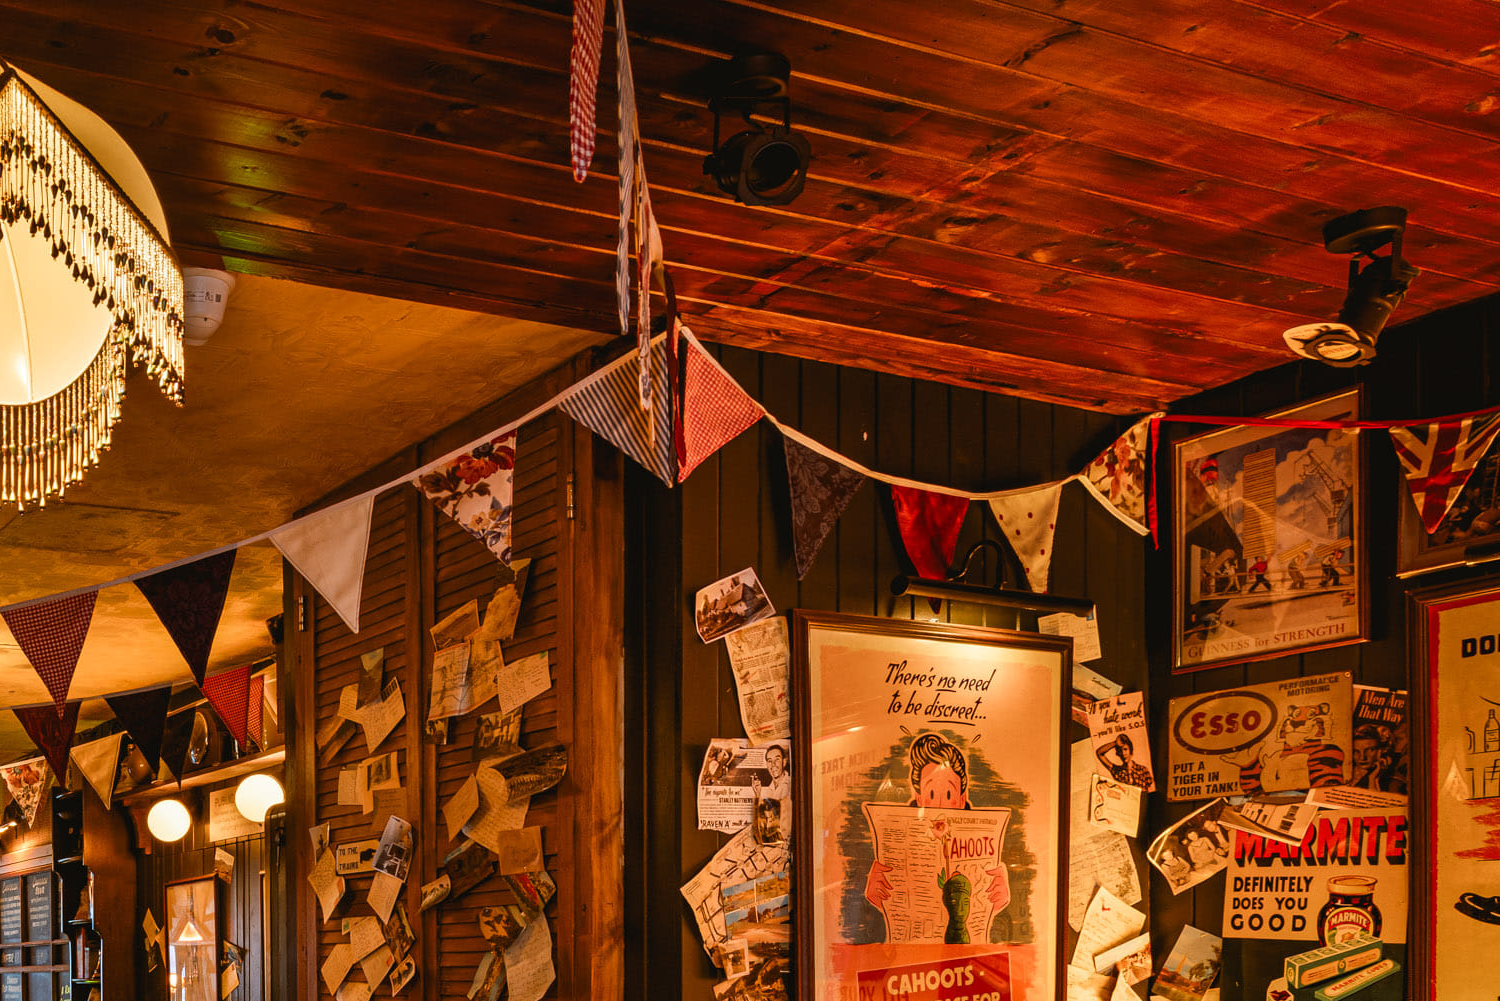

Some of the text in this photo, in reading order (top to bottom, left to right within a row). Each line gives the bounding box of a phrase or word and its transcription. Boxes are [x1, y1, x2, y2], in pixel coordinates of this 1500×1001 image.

[1254, 637, 1269, 648] for
[1273, 622, 1345, 644] STRENGTH
[1461, 633, 1500, 658] DO
[885, 660, 996, 692] There's no need
[887, 690, 902, 714] to
[904, 690, 922, 715] be
[1362, 690, 1405, 709] Men Are
[1359, 704, 1405, 723] That Way
[1173, 761, 1205, 774] PUT A
[1172, 771, 1219, 786] TIGER IN
[1172, 781, 1238, 797] YOUR TANK!
[1235, 815, 1407, 867] MARMITE
[1233, 876, 1314, 893] DEFINITELY
[1232, 897, 1308, 911] DOES YOU
[1230, 914, 1307, 932] GOOD
[1330, 912, 1369, 927] MARMITE
[887, 965, 974, 995] CAHOOTS
